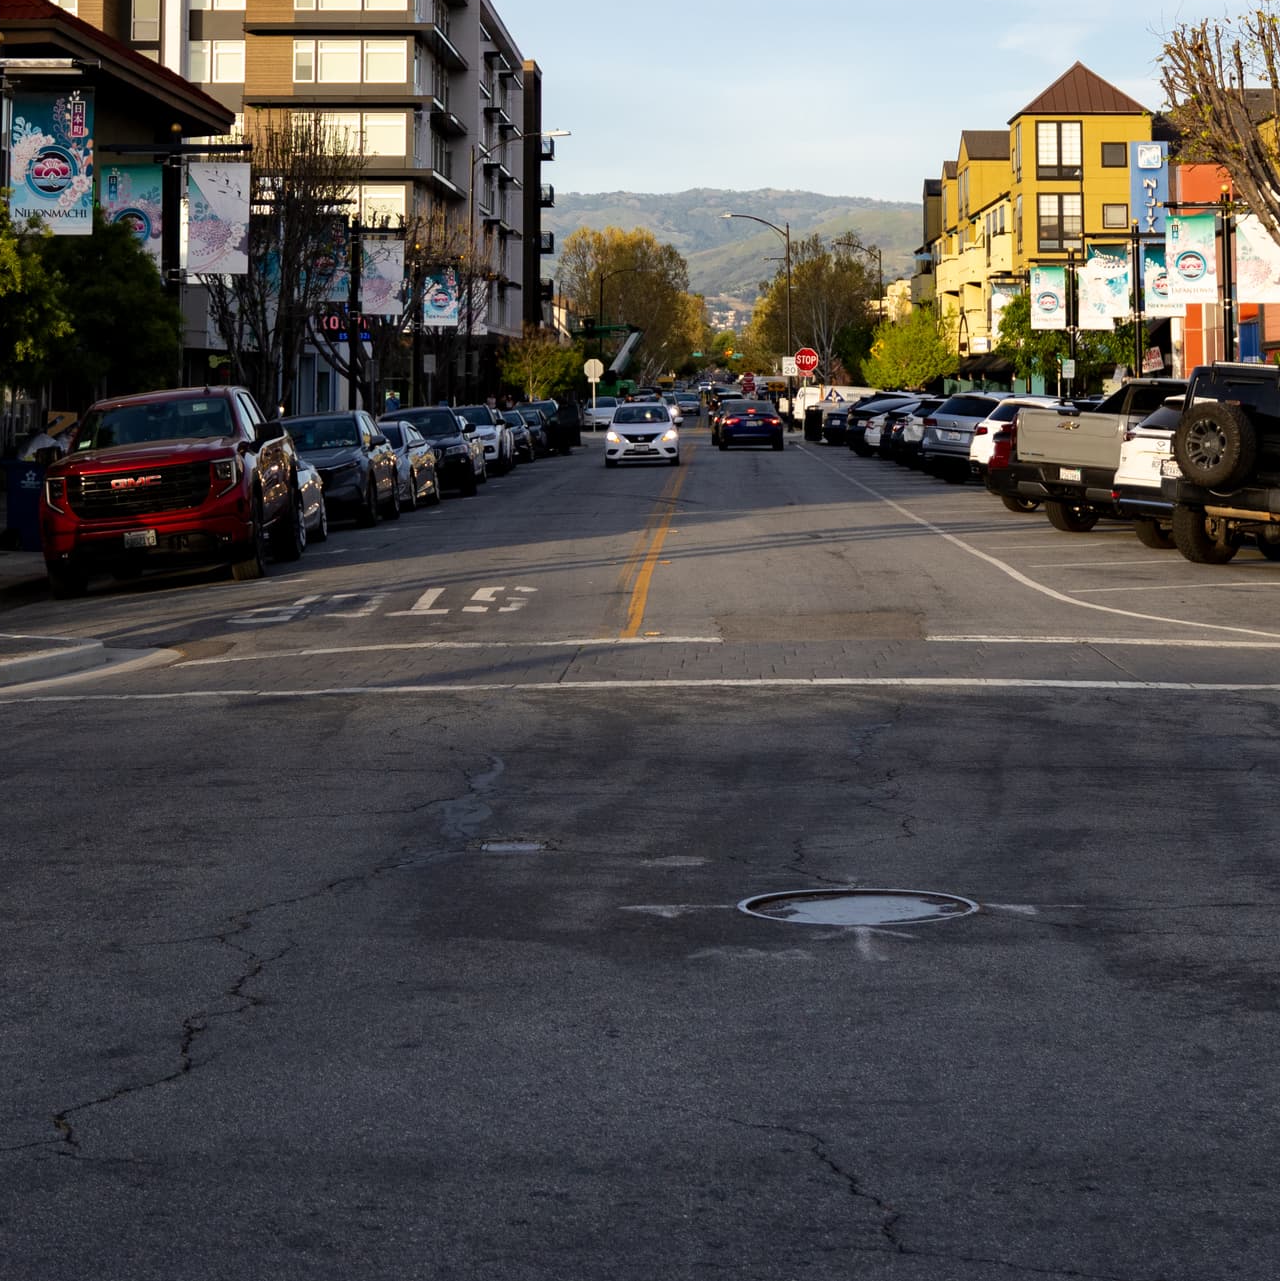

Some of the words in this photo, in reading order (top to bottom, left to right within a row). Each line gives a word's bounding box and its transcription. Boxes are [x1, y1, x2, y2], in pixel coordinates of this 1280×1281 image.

[14, 207, 87, 219] NIHONMACHI
[797, 354, 817, 365] STOP
[784, 367, 796, 375] 20
